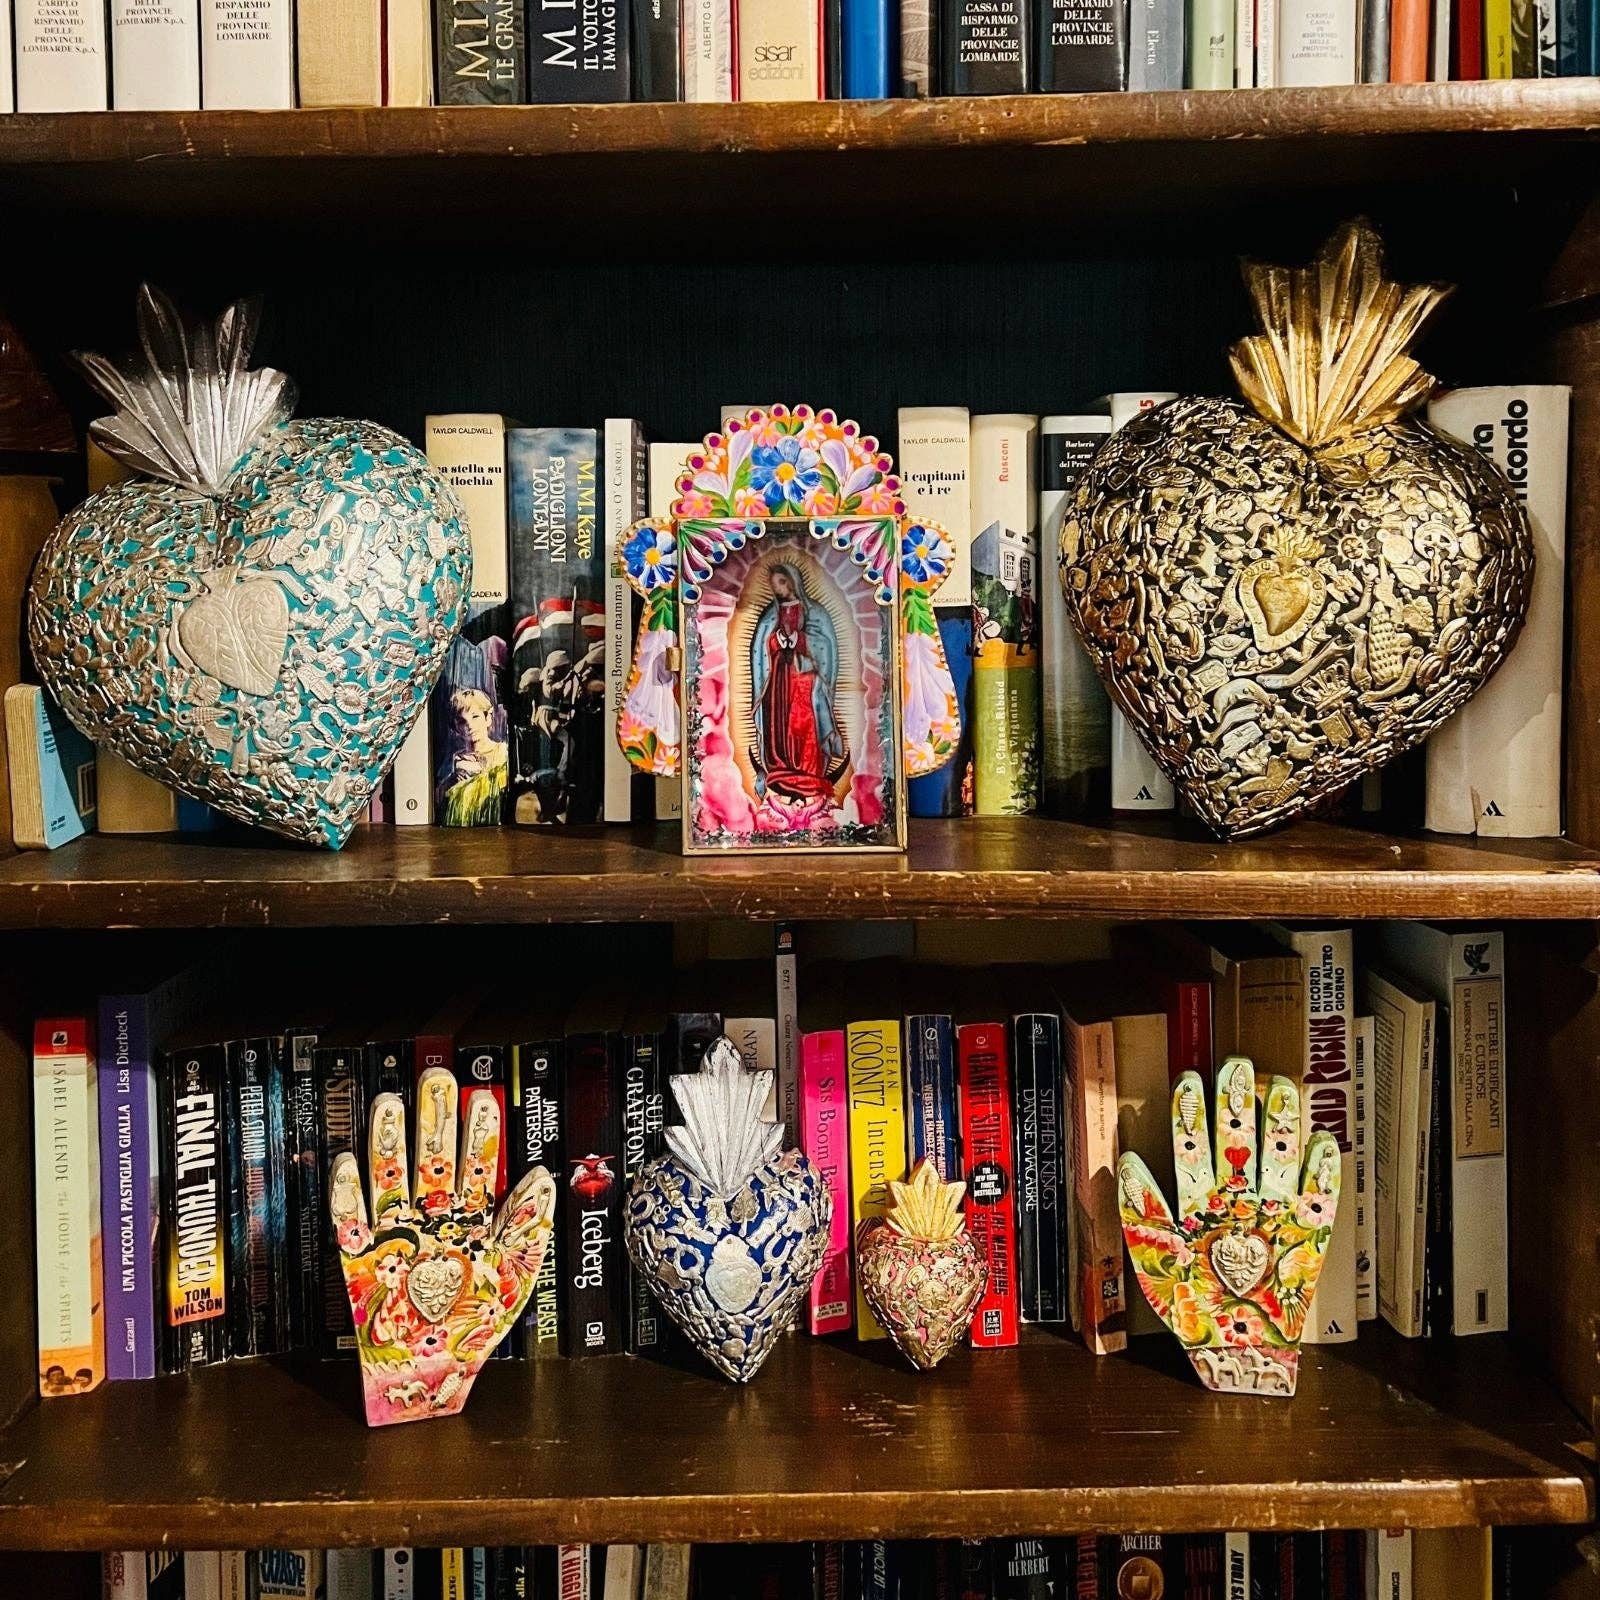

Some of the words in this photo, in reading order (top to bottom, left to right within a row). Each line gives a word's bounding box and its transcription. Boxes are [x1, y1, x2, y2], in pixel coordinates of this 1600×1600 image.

[126, 8, 173, 16] PROVINCIE
[215, 1, 271, 9] RISPARMIO
[226, 11, 259, 20] DELLE
[965, 3, 999, 13] CASSA
[1001, 3, 1013, 13] DI
[1053, 0, 1114, 9] RISPARMIO
[1064, 10, 1102, 20] DELLE
[34, 18, 84, 26] RISPARMIO
[116, 18, 162, 26] LOMBARDE
[216, 21, 271, 31] PROVINCIE
[961, 15, 1019, 26] RISPARMIO
[972, 28, 1008, 38] DELLE
[1052, 22, 1114, 33] PROVINCIE
[23, 46, 73, 54] LOMBARDE
[35, 36, 82, 44] PROVINCIE
[216, 32, 272, 41] LOMBARDE
[453, 0, 491, 81] MI
[703, 13, 712, 60] ALBERTO
[960, 40, 1019, 50] PROVINCIE
[1051, 34, 1115, 45] LOMBARDE
[1146, 30, 1158, 66] Electa
[584, 55, 600, 71] IL
[754, 42, 798, 63] sisar
[960, 52, 1020, 62] LOMBARDE
[496, 57, 515, 80] LE
[747, 63, 805, 81] edizioni
[432, 427, 457, 435] TAYLOR
[458, 427, 494, 435] CALDWELL
[931, 437, 966, 445] CALDWELL
[451, 462, 485, 474] stella
[487, 465, 502, 474] su
[999, 438, 1010, 483] Rusconi
[1059, 460, 1070, 468] del
[1066, 452, 1076, 460] Le
[903, 471, 909, 482] i
[911, 469, 966, 486] capitani
[917, 486, 926, 496] e
[928, 484, 934, 496] i
[936, 486, 952, 496] re
[532, 468, 550, 551] LONTANI
[549, 456, 567, 564] PADIGLIONI
[470, 590, 502, 598] CADEMIA
[614, 583, 623, 631] mamma
[611, 633, 623, 678] Browne
[611, 681, 623, 713] Agnes
[1009, 689, 1020, 748] Virginiana
[1009, 752, 1019, 766] La
[1322, 944, 1334, 980] ALTRO
[1309, 965, 1321, 1013] RICORDI
[1322, 981, 1334, 999] UN
[1334, 966, 1345, 1012] GIORNO
[1322, 1000, 1334, 1012] DI
[114, 1010, 130, 1065] Dierbeck
[1463, 1000, 1473, 1053] MISSIONARI
[1475, 1032, 1486, 1040] E
[1487, 1001, 1499, 1056] LETTERE
[1302, 1014, 1352, 1085] ROBBINS
[116, 1068, 130, 1093] Lisa
[849, 1029, 886, 1110] KOONTZ
[886, 1045, 899, 1089] DEAN
[966, 1051, 1001, 1107] DANIEL
[1475, 1044, 1487, 1100] CURIOSE
[52, 1063, 67, 1111] ISABEL
[239, 1085, 265, 1118] PETER
[818, 1076, 837, 1103] Sis
[923, 1083, 934, 1120] WEBSTER
[1488, 1059, 1501, 1129] EDIFICANTI
[301, 1077, 314, 1134] HIGGINS
[542, 1097, 560, 1143] JAMES
[625, 1066, 645, 1166] GRAFTON
[644, 1092, 664, 1135] SUE
[1023, 1088, 1037, 1141] DANSE
[1464, 1091, 1474, 1122] DALLA
[117, 1103, 132, 1149] GIALLA
[176, 1093, 216, 1180] FINAL
[525, 1086, 543, 1162] PATTERSON
[816, 1108, 837, 1162] Boom
[925, 1120, 936, 1149] HANDY
[935, 1119, 946, 1134] THE
[969, 1111, 1002, 1159] SILVA
[1040, 1088, 1057, 1155] STEPHEN
[54, 1117, 69, 1183] ALLENDE
[241, 1118, 266, 1161] STRAUB
[935, 1135, 947, 1154] NEW
[863, 1119, 889, 1207] Intensity
[1024, 1144, 1039, 1213] MACABRE
[119, 1151, 134, 1212] PASTIGLIA
[58, 1211, 71, 1257] HOUSE
[121, 1214, 135, 1267] PICCOLA
[176, 1179, 217, 1288] THUNDER
[573, 1206, 612, 1290] Iceberg
[122, 1268, 136, 1292] UNA
[537, 1258, 557, 1286] THE
[174, 1297, 224, 1320] WILSON
[184, 1287, 212, 1304] TOM
[59, 1293, 72, 1345] SPIRITS
[536, 1288, 558, 1344] WEASEL
[124, 1317, 135, 1353] Garzanti
[1013, 1540, 1044, 1561] JAMES
[1119, 1535, 1163, 1552] ARCHER
[514, 1565, 526, 1575] Z
[873, 1544, 886, 1576] ZONA
[1008, 1556, 1050, 1577] HERBERT
[1230, 1548, 1245, 1585] TODAY
[514, 1577, 526, 1599] alla
[873, 1574, 886, 1589] LA
